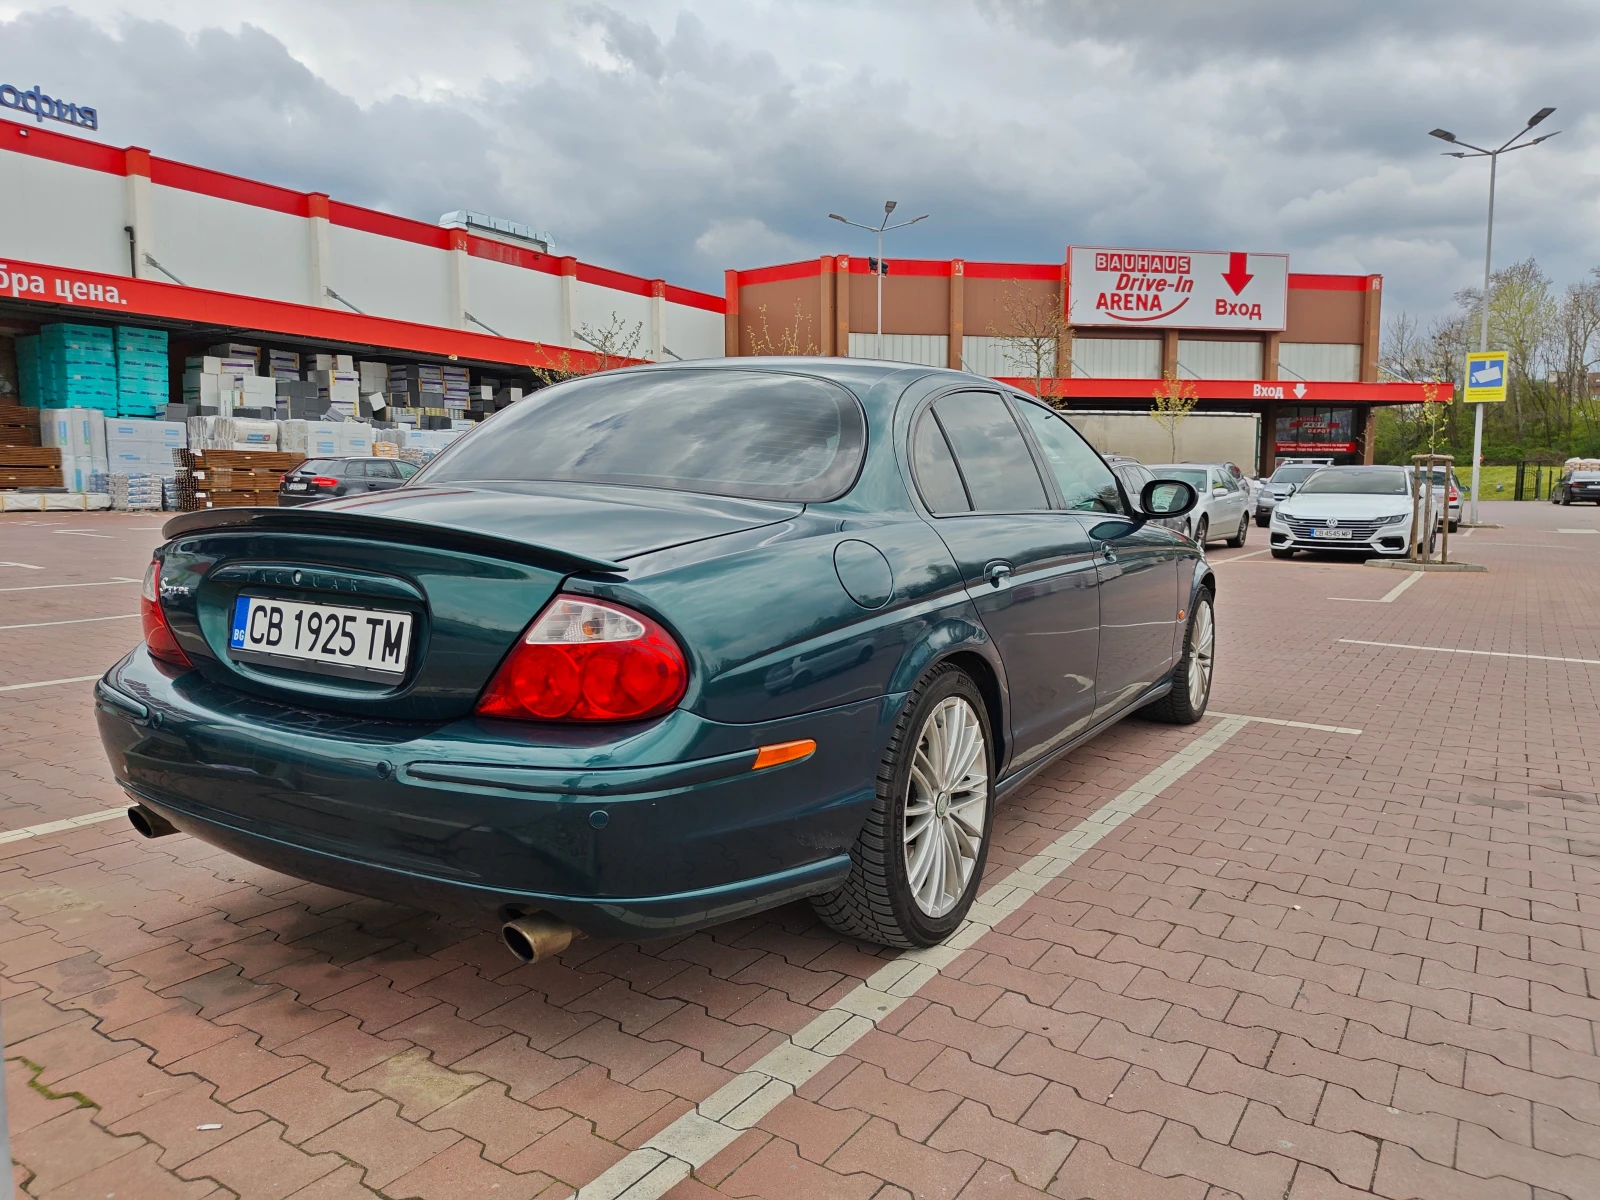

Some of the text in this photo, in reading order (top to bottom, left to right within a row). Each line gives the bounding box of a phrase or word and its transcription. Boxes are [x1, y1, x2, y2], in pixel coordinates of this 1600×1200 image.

[1096, 253, 1190, 273] BAUHAUS
[55, 278, 128, 304] цена.
[1115, 273, 1194, 293] Drive-In
[1096, 292, 1162, 311] ARENA
[1215, 299, 1262, 320] Вход
[1253, 383, 1284, 399] Вход
[233, 628, 245, 641] BG
[250, 605, 405, 664] CB 1925 TM
